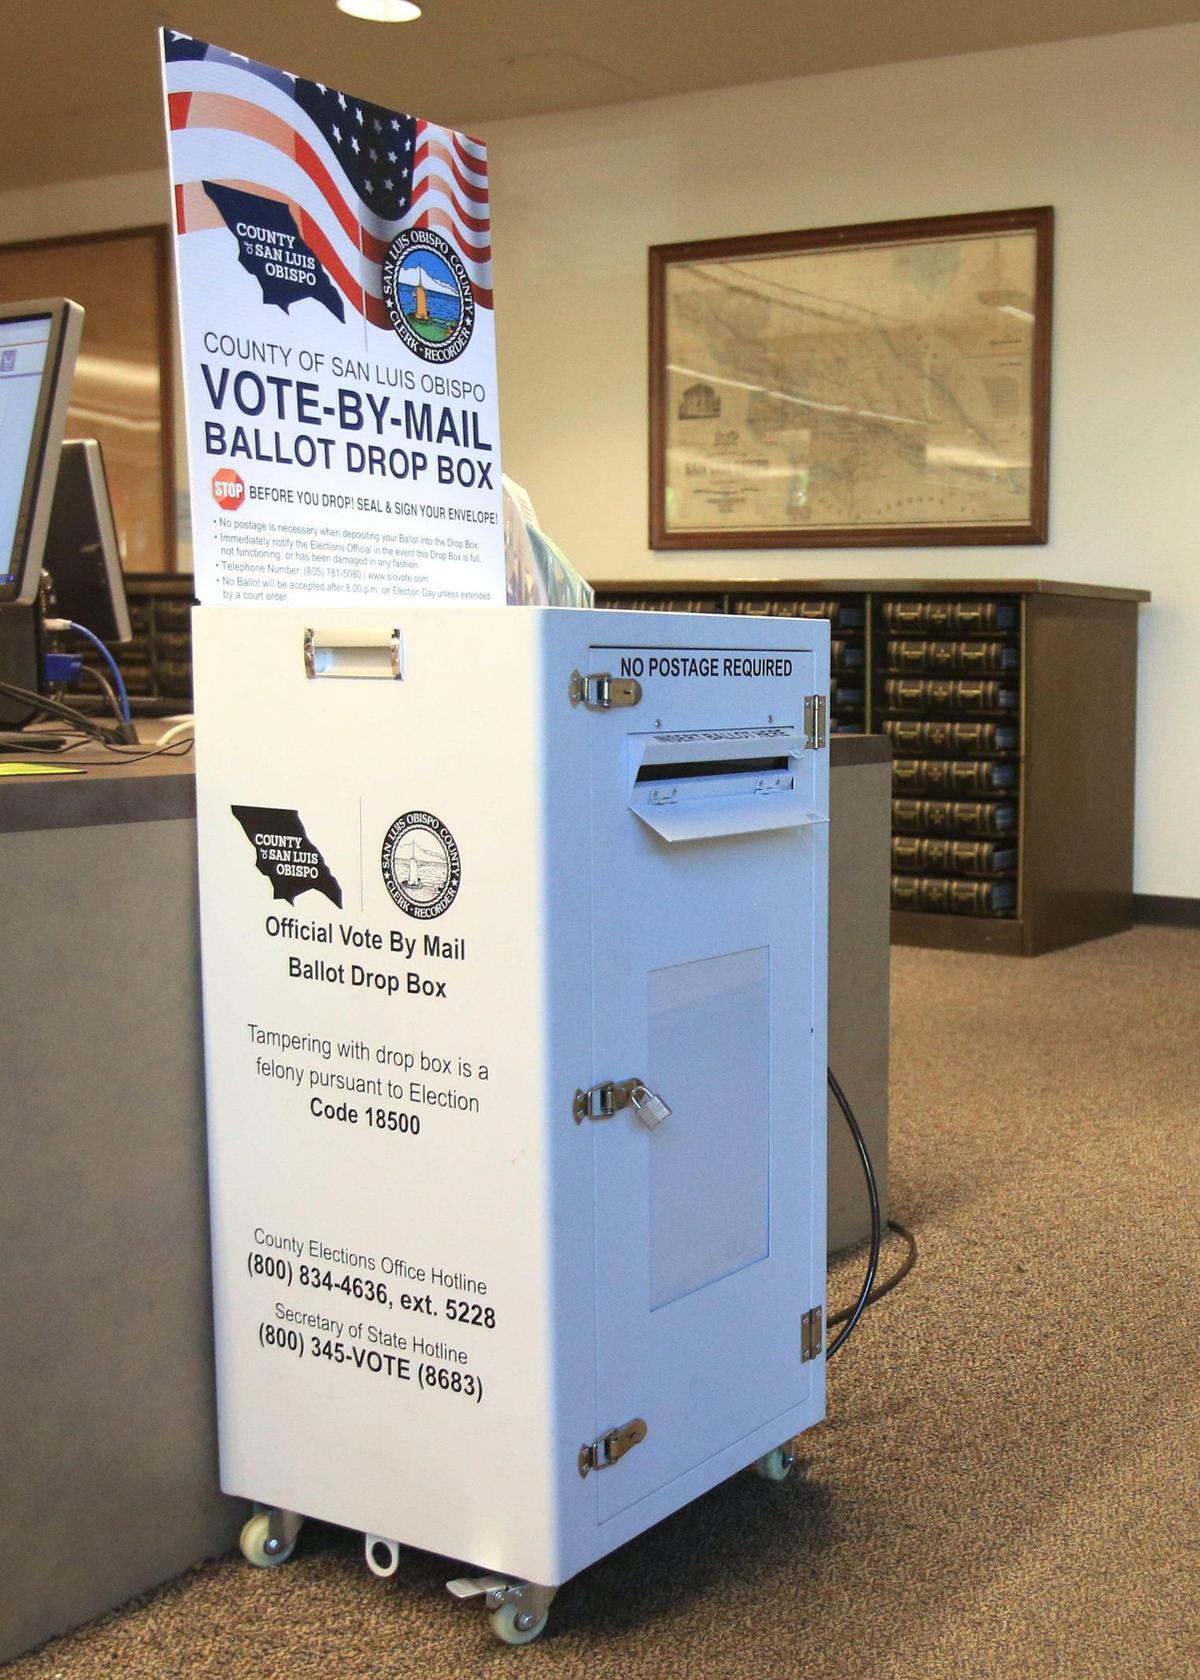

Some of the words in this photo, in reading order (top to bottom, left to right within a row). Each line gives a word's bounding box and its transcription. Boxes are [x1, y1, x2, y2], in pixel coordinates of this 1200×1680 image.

[237, 223, 295, 249] COUNTY
[255, 244, 282, 262] SAN
[285, 251, 315, 270] LUIS
[265, 263, 316, 285] OBISPO
[384, 261, 394, 295] SAN
[389, 234, 409, 260] LUIS
[410, 231, 448, 254] OBISPO
[450, 255, 473, 315] COUNTY
[390, 311, 419, 351] CLERK
[425, 327, 471, 361] RECORDER
[204, 332, 292, 367] COUNTY
[299, 351, 325, 372] OF
[332, 357, 370, 382] SAN
[376, 366, 415, 390] LUIS
[421, 374, 486, 402] OBISPO
[200, 363, 492, 452] VOTE-BY-MAIL
[204, 420, 335, 470] BALLOT
[346, 442, 427, 480] DROP
[438, 455, 494, 490] BOX
[215, 482, 243, 498] STOP
[250, 485, 294, 503] BEFORE
[297, 491, 319, 506] YOU
[322, 494, 354, 510] DROP!
[357, 498, 383, 513] SEAL
[385, 501, 392, 513] &
[395, 502, 417, 516] SIGN
[420, 504, 446, 519] YOUR
[448, 508, 498, 524] ENVELOPE!
[219, 517, 232, 527] No
[234, 520, 267, 532] postage
[269, 522, 276, 530] is
[278, 525, 318, 536] necessary
[320, 528, 340, 537] when
[342, 529, 380, 542] depositing
[382, 534, 397, 543] your
[399, 534, 418, 544] Ballot
[420, 536, 432, 545] into
[435, 538, 445, 546] the
[447, 538, 463, 549] Drop
[220, 533, 270, 547] Immediately
[273, 539, 293, 549] notify
[296, 540, 308, 549] the
[311, 540, 344, 551] Elections
[347, 543, 371, 553] Official
[382, 547, 393, 555] the
[396, 548, 414, 556] event
[416, 550, 428, 558] this
[430, 550, 446, 560] Drop
[449, 552, 461, 560] Box
[463, 554, 468, 562] is
[221, 547, 234, 556] not
[285, 552, 293, 560] or
[296, 552, 309, 561] has
[312, 553, 330, 563] been
[333, 554, 367, 566] damaged
[378, 559, 392, 568] any
[221, 560, 265, 573] Telephone
[304, 566, 324, 576] (805)
[327, 568, 361, 579] 781-5080
[222, 576, 234, 586] No
[237, 577, 260, 587] Ballot
[263, 579, 275, 588] will
[278, 580, 288, 589] be
[290, 582, 325, 592] accepted
[327, 582, 344, 592] after
[393, 586, 420, 596] Election
[422, 588, 435, 598] Day
[438, 590, 458, 599] unless
[461, 591, 490, 600] extended
[223, 590, 233, 601] by
[236, 591, 241, 599] a
[244, 592, 263, 600] court
[621, 658, 644, 677] NO
[649, 658, 719, 677] POSTAGE
[724, 659, 793, 677] REQUIRED
[653, 734, 704, 743] INSERT
[702, 731, 754, 740] BALLOT
[752, 729, 790, 738] HERE
[256, 833, 302, 848] COUNTY
[269, 849, 291, 861] SAN
[293, 851, 318, 864] LUIS
[383, 842, 392, 869] SAN
[388, 819, 406, 840] LUIS
[407, 813, 439, 828] OBISPO
[441, 828, 459, 876] COUNTY
[276, 864, 318, 879] OBISPO
[387, 881, 409, 911] CLERK
[415, 888, 456, 918] RECORDER
[265, 916, 333, 944] Official
[339, 924, 383, 949] Vote
[390, 930, 416, 959] By
[424, 934, 466, 960] Mail
[289, 956, 344, 984] Ballot
[351, 964, 399, 996] Drop
[407, 972, 447, 998] Box
[248, 1024, 332, 1059] Tampering
[337, 1039, 370, 1061] with
[376, 1045, 414, 1072] drop
[420, 1051, 452, 1074] box
[458, 1057, 472, 1078] is
[478, 1065, 489, 1080] a
[256, 1057, 304, 1087] felony
[310, 1070, 382, 1096] pursuant
[388, 1080, 403, 1099] to
[410, 1082, 479, 1112] Election
[311, 1097, 358, 1124] Code
[365, 1107, 421, 1135] 18500
[254, 1228, 304, 1258] County
[309, 1240, 376, 1271] Elections
[381, 1256, 426, 1282] Office
[431, 1267, 487, 1295] Hotline
[248, 1252, 293, 1287] (800)
[300, 1265, 393, 1310] 834-4636,
[400, 1293, 438, 1316] ext.
[446, 1298, 496, 1329] 5228
[275, 1302, 344, 1338] Secretary
[349, 1323, 363, 1340] of
[368, 1326, 407, 1350] State
[412, 1336, 468, 1365] Hotline
[259, 1322, 305, 1357] (800)
[311, 1336, 411, 1381] 345-VOTE
[418, 1363, 483, 1403] (8683)
